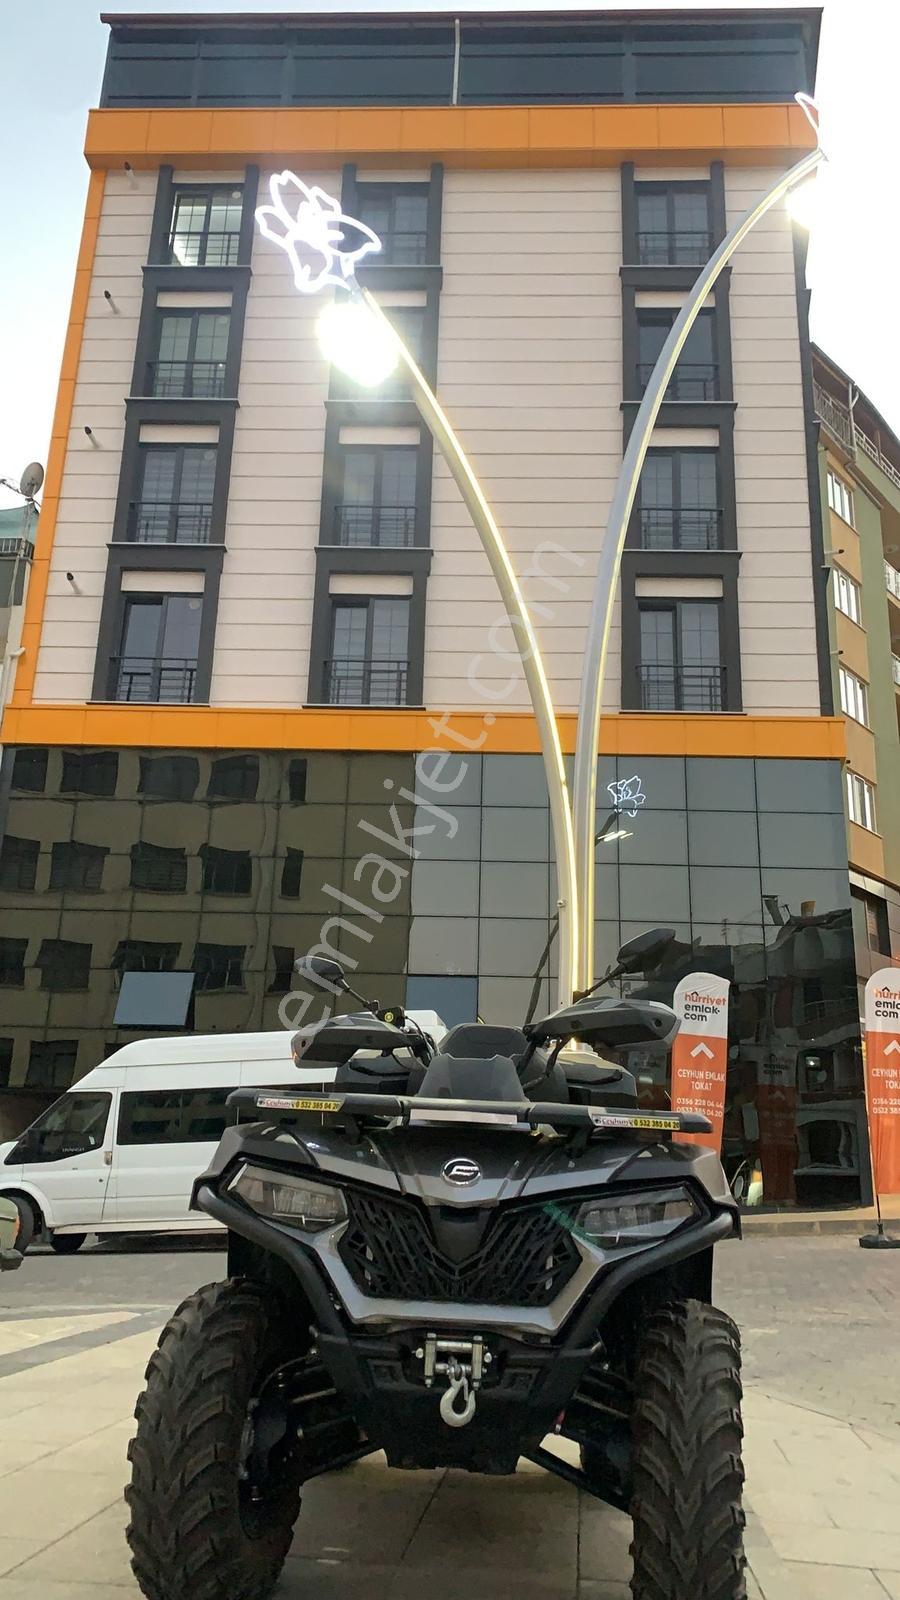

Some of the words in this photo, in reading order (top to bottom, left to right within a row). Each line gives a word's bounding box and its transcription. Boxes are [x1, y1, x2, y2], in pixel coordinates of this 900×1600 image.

[875, 1000, 900, 1010] emla
[684, 1012, 708, 1022] com
[875, 1009, 899, 1019] com
[677, 1069, 704, 1079] CEYHUN
[705, 1071, 726, 1082] EMLAK
[691, 1081, 713, 1091] TOKAT
[640, 1119, 650, 1127] 532
